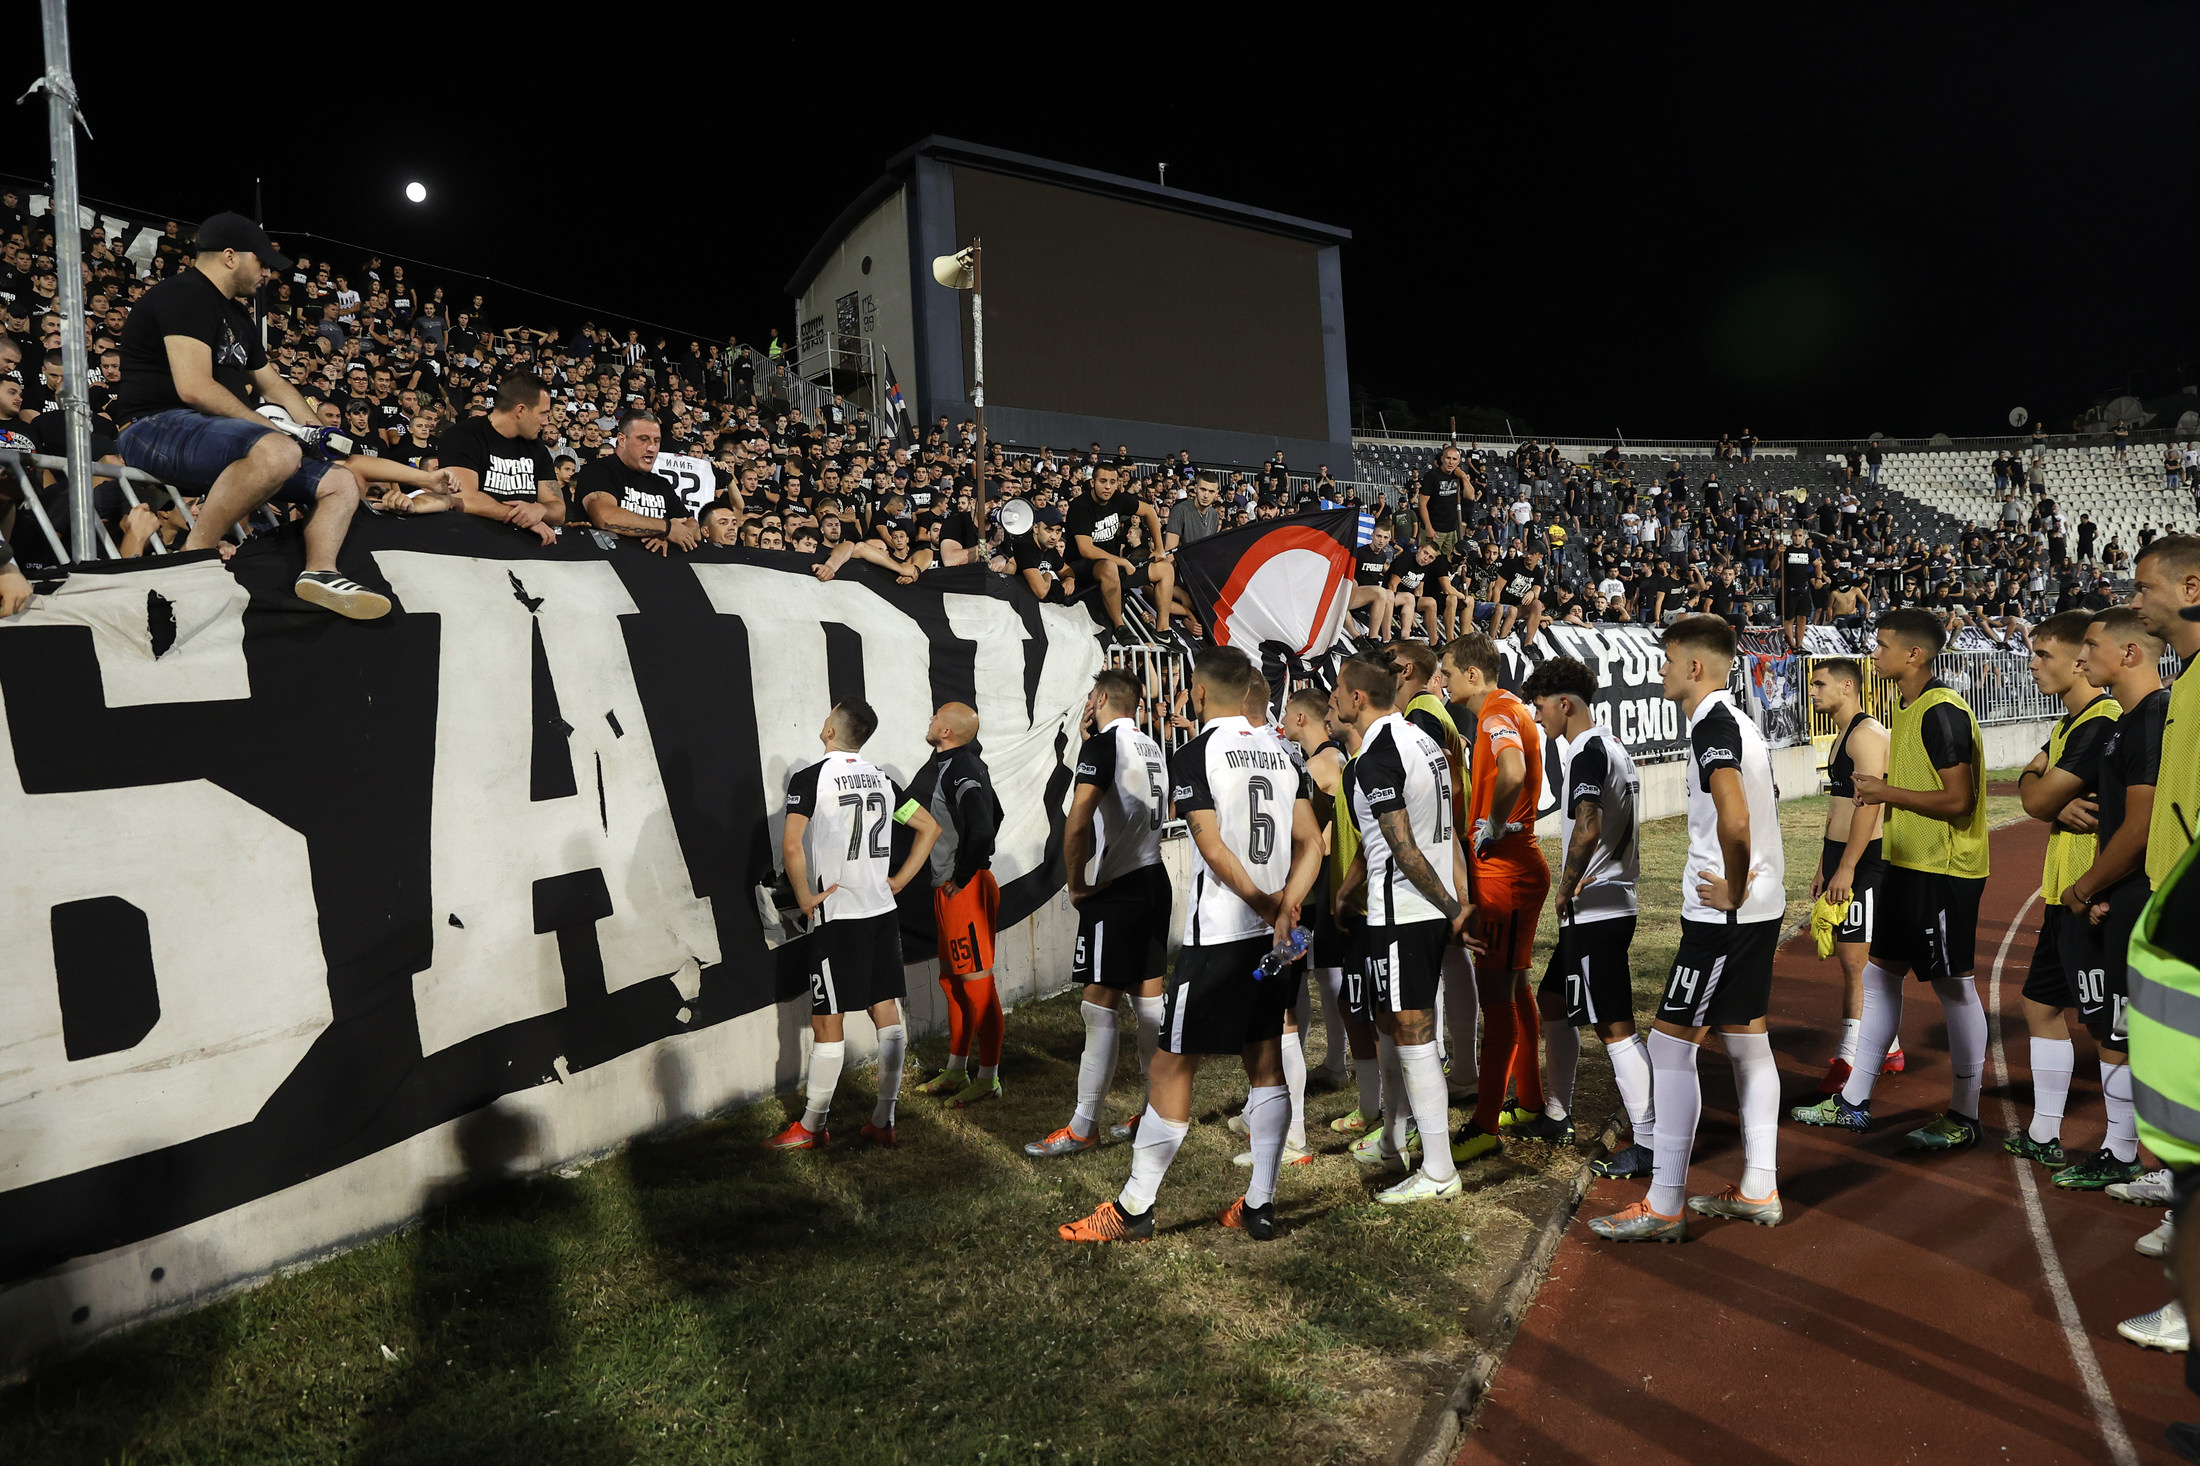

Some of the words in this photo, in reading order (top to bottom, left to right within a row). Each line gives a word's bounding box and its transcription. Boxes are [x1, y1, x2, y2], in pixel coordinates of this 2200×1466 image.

[665, 458, 693, 470] ИЛИЋ
[1618, 696, 1679, 746] СМО
[1225, 751, 1287, 771] МАРКОВИЋ
[833, 773, 882, 792] УРОШЕВИЋ
[1146, 761, 1164, 831] 5
[838, 792, 890, 861] 72
[1248, 775, 1276, 865] 6
[950, 936, 972, 962] 85
[1075, 936, 1086, 965] 5
[1347, 974, 1362, 1004] 17
[1373, 957, 1388, 993] 15
[1667, 964, 1701, 1004] 14
[2077, 968, 2105, 1004] 90
